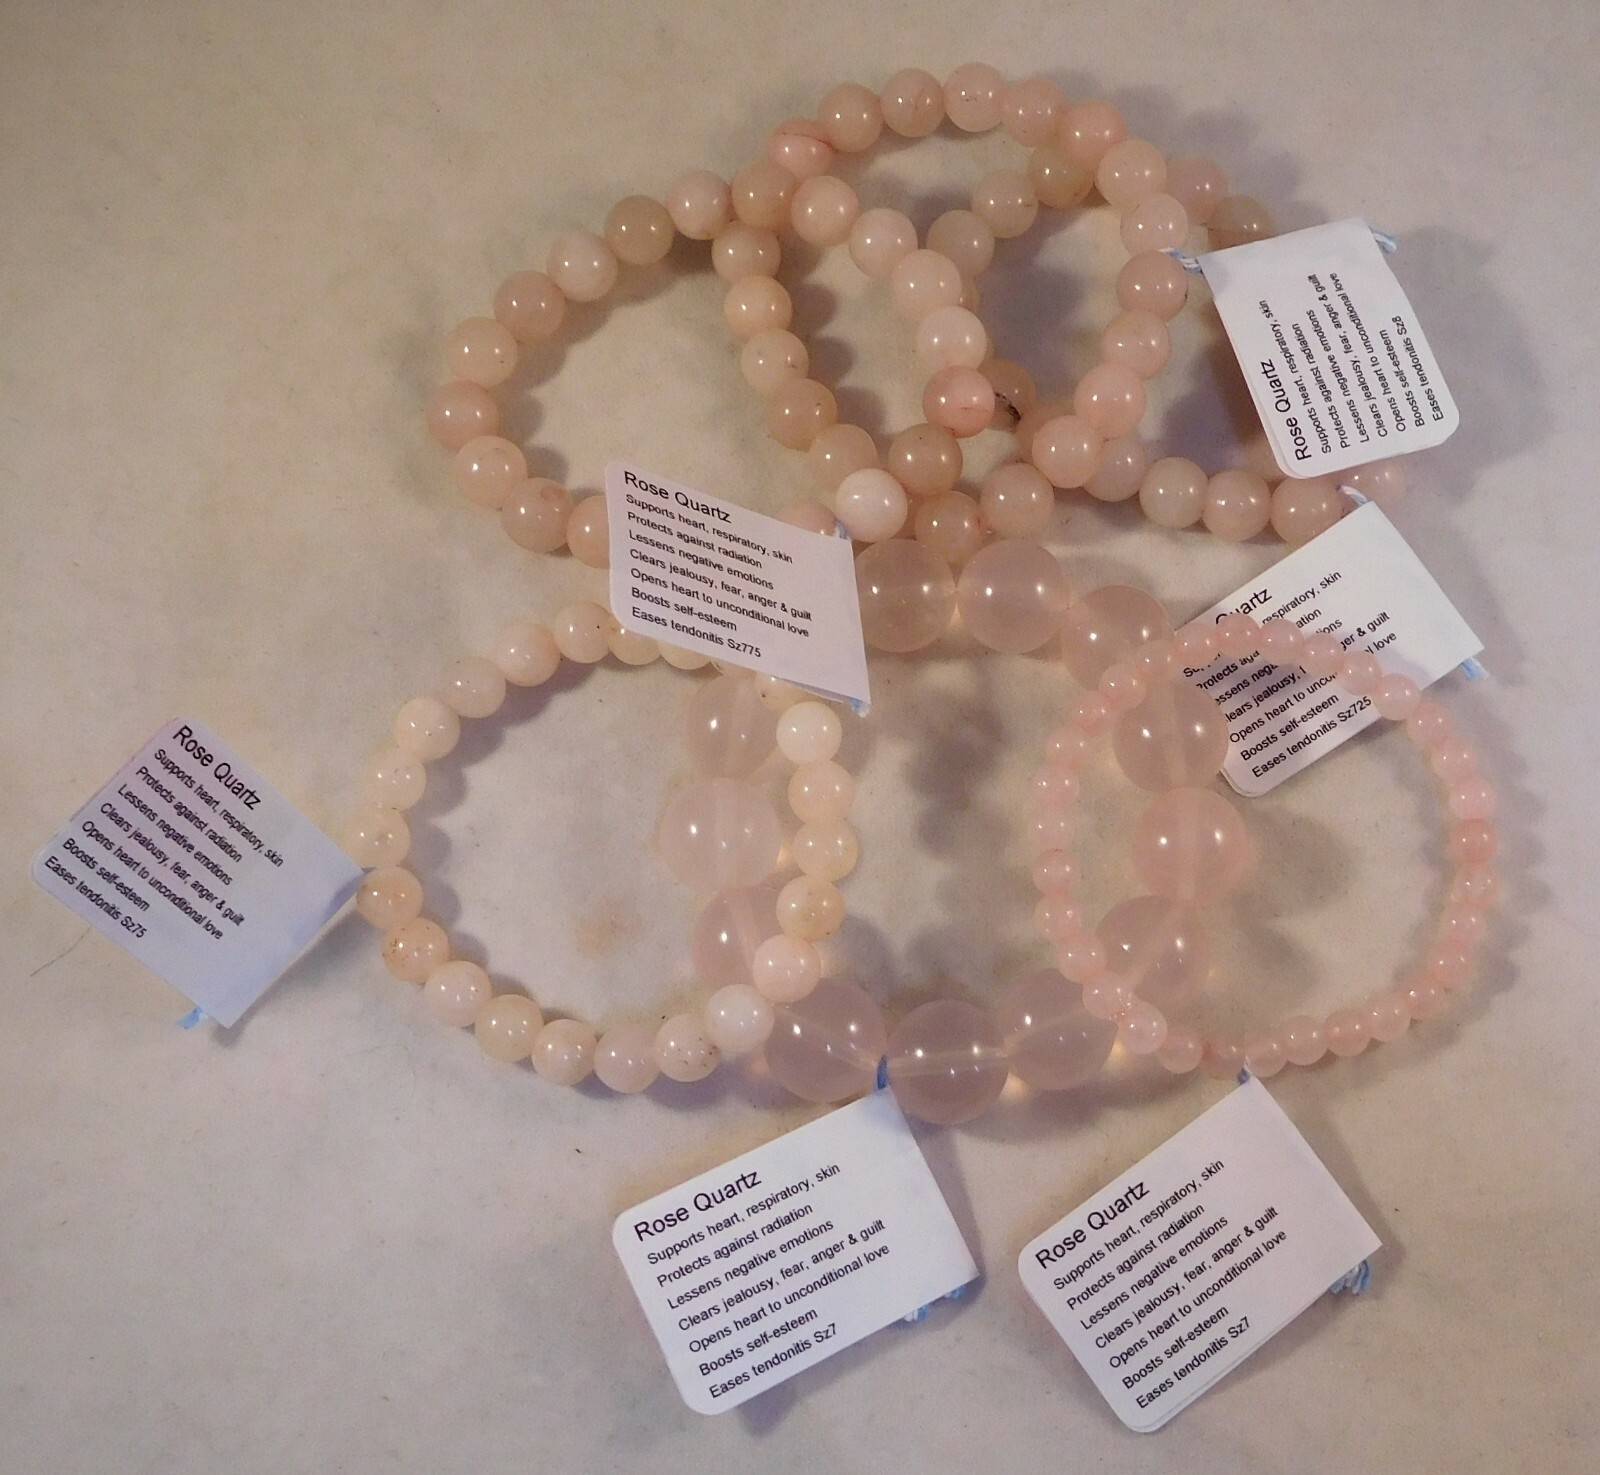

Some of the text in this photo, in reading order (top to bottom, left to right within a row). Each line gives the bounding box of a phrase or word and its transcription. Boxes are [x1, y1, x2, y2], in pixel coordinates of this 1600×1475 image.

[1259, 300, 1332, 454] Supports heart, respiratory, skin
[1292, 323, 1351, 449] Protects against radiation
[1306, 309, 1370, 443] Lessens negative emotions
[1307, 274, 1388, 438] Clears jealousy, fear, anger & guilt
[1330, 273, 1406, 432] Opens heart to unconditional love
[1379, 329, 1426, 428] Boosts self-esteem
[1391, 316, 1444, 422] Eases tendonitis Sz8
[1260, 358, 1312, 461] Rose Quartz
[624, 470, 732, 524] Rose Quartz
[626, 494, 793, 564] Supports heart, respiratory, skin
[627, 511, 762, 569] Protects against radiation
[628, 529, 774, 590] Lessens negative emotions
[630, 548, 812, 621] Clears jealousy, fear, anger & guilt
[630, 568, 809, 637] Opens heart to unconditional love
[1320, 571, 1342, 589] skin
[631, 586, 737, 632] Boosts self-esteem
[632, 606, 762, 658] Eases tendonitis Sz775
[1226, 702, 1252, 722] lears
[1252, 672, 1300, 707] jealousy,
[1357, 627, 1366, 637] &
[1367, 612, 1390, 632] guilt
[1230, 717, 1265, 744] Opens
[1264, 698, 1294, 722] heart
[1293, 691, 1306, 704] to
[1374, 632, 1397, 652] love
[172, 724, 262, 811] Rose Quartz
[1240, 694, 1339, 761] Boosts self-esteem
[1252, 696, 1372, 778] Eases tendonitis Sz725
[117, 783, 233, 886] Lessens negative emotions
[135, 766, 243, 863] Protects against radiation
[154, 748, 284, 867] Supports heart, respiratory, skin
[44, 855, 148, 938] Eases tendonitis Sz75
[62, 837, 150, 912] Boosts self-esteem
[82, 820, 223, 940] Opens heart to unconditional love
[100, 802, 245, 926] Clears jealousy, fear, anger & guilt
[634, 1171, 762, 1242] Rose Quartz
[647, 1164, 840, 1265] Supports heart, respiratory, skin
[656, 1204, 813, 1288] Protects against radiation
[1034, 1182, 1150, 1270] Rose Quartz
[1053, 1160, 1225, 1290] Supports heart, respiratory, skin
[667, 1220, 834, 1310] Lessens negative emotions
[678, 1219, 886, 1331] Clears jealousy, fear, anger & guilt
[689, 1245, 890, 1352] Opens heart to unconditional love
[1066, 1205, 1205, 1310] Protects against radiation
[1080, 1216, 1228, 1330] Lessens negative emotions
[1095, 1206, 1279, 1348] Clears jealousy, fear, anger & guilt
[1109, 1231, 1286, 1368] Opens heart to unconditional love
[698, 1309, 818, 1376] Boosts self-esteem
[708, 1322, 836, 1399] Eases tendonitis Sz7
[1122, 1306, 1229, 1390] Boosts self-esteem
[1135, 1316, 1250, 1409] Eases tendonitis Sz7
